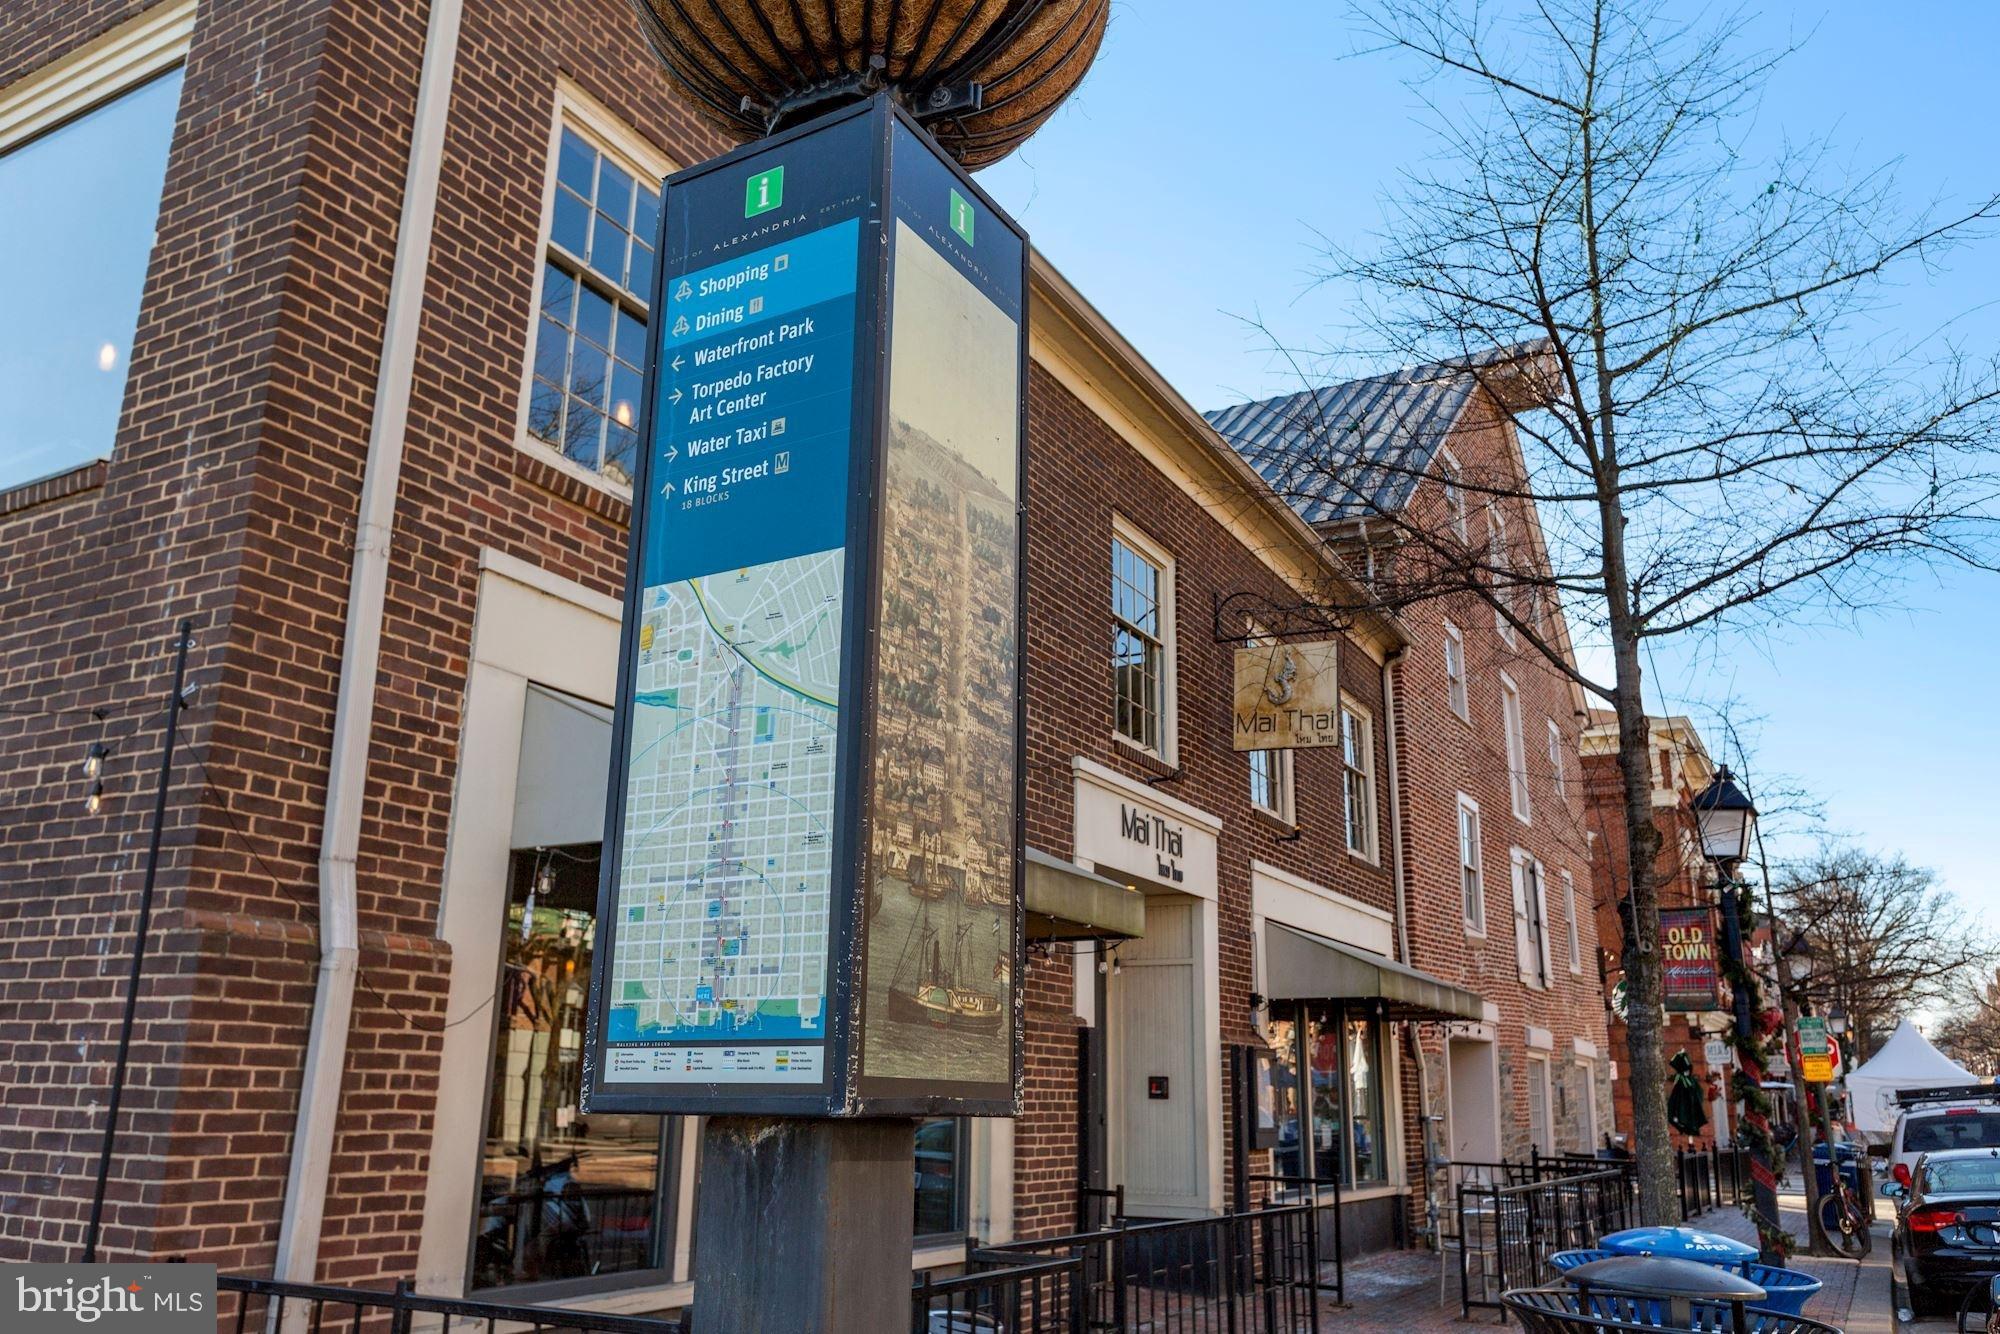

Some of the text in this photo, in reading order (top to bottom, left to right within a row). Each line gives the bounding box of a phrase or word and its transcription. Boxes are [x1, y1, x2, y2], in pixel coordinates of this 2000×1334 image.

[670, 255, 689, 265] CITY
[692, 250, 703, 258] OF
[713, 214, 807, 251] ALEXANDRIA
[928, 225, 989, 283] ALEXANDRIA
[699, 262, 770, 297] Shopping
[696, 305, 745, 333] Dining
[694, 317, 815, 367] Waterfront Park
[692, 354, 815, 400] Torpedo Factory
[689, 391, 767, 425] Art Center
[687, 421, 768, 458] Water Taxi
[683, 475, 718, 496] King
[721, 460, 769, 486] Street
[681, 491, 730, 511] 18 BLOCKS
[1237, 709, 1335, 734] Mai Thai
[1121, 803, 1183, 859] Mai Thai
[1662, 943, 1712, 961] TOWN
[1668, 927, 1703, 945] OLD
[1684, 1243, 1732, 1251] PAPER
